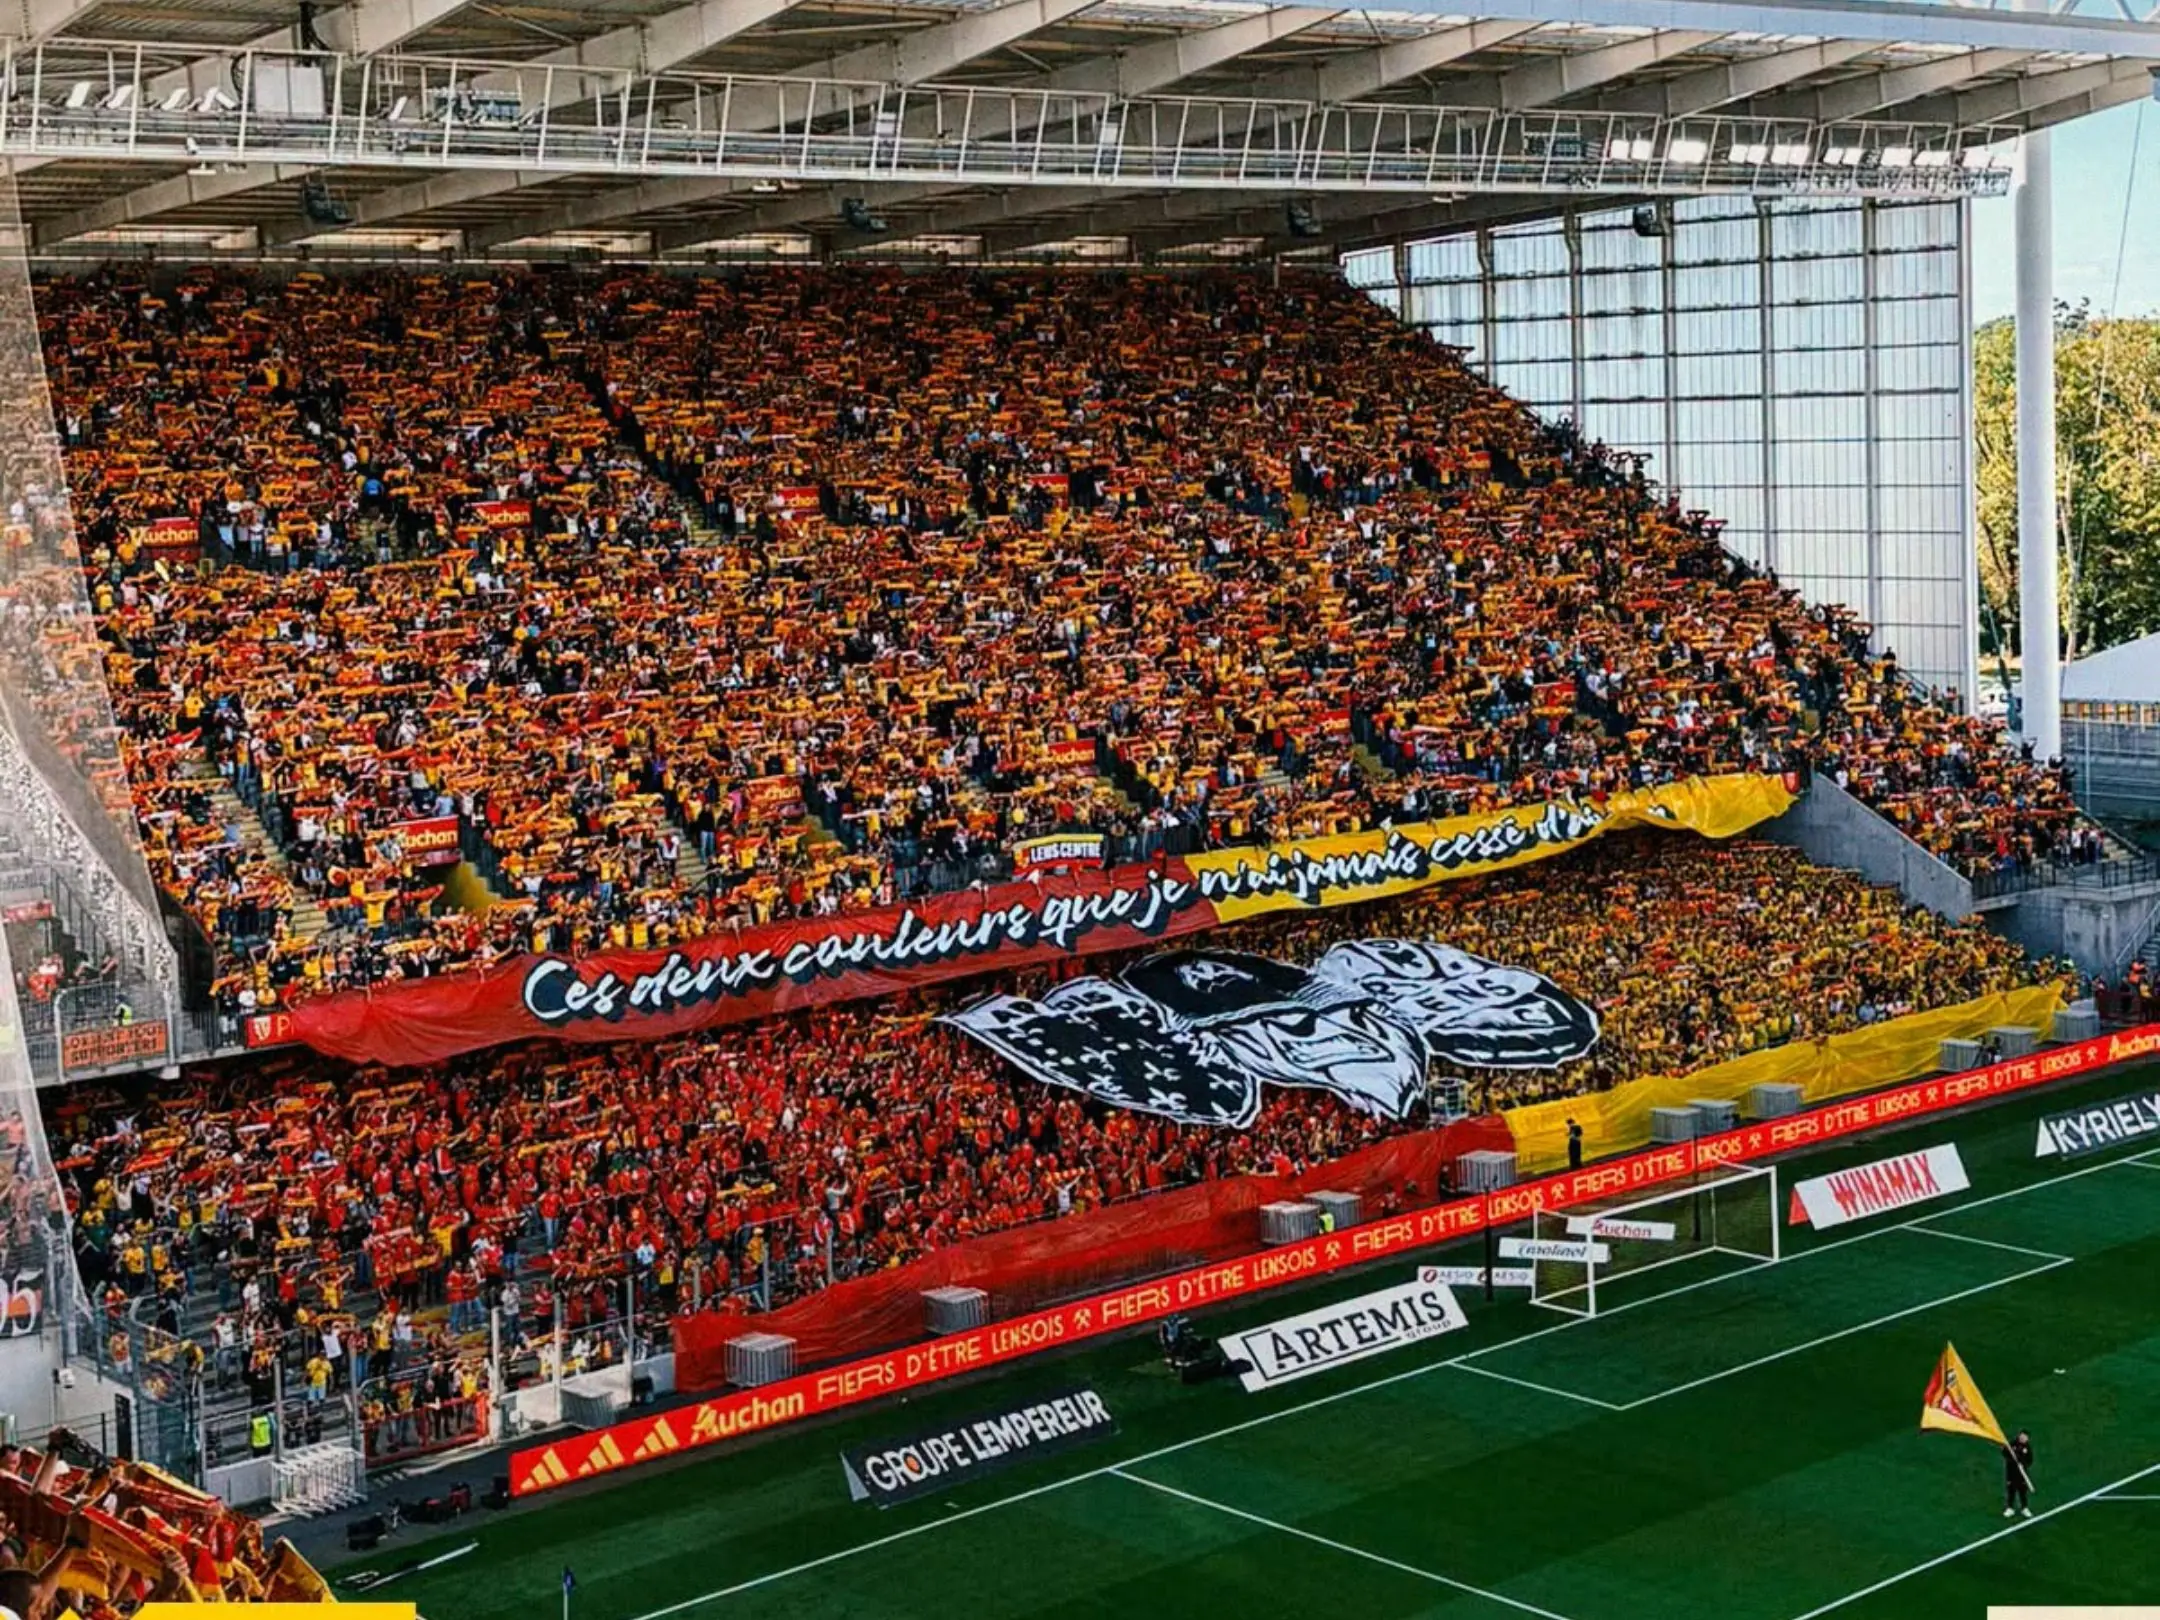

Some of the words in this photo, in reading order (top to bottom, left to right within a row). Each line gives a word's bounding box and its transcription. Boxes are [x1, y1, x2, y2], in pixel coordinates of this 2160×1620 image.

[524, 959, 625, 1019] Ces
[629, 952, 777, 1007] deux
[783, 903, 1032, 974] couleurs
[1038, 888, 1140, 948] que
[1131, 869, 1190, 929] je
[1286, 831, 1421, 898] jamais
[1826, 1152, 1942, 1218] WINAMAX
[1353, 1220, 1414, 1254] FIERS
[1102, 1285, 1171, 1324] FIERS
[1253, 1246, 1317, 1282] LENSOIS
[817, 1361, 896, 1402] FIERS
[991, 1314, 1065, 1356] LENSOIS
[1270, 1291, 1447, 1370] ARTEMIS
[690, 1391, 805, 1446] Auchan
[865, 1431, 972, 1492] GROUPE
[959, 1389, 1112, 1462] LEMPEREUR
